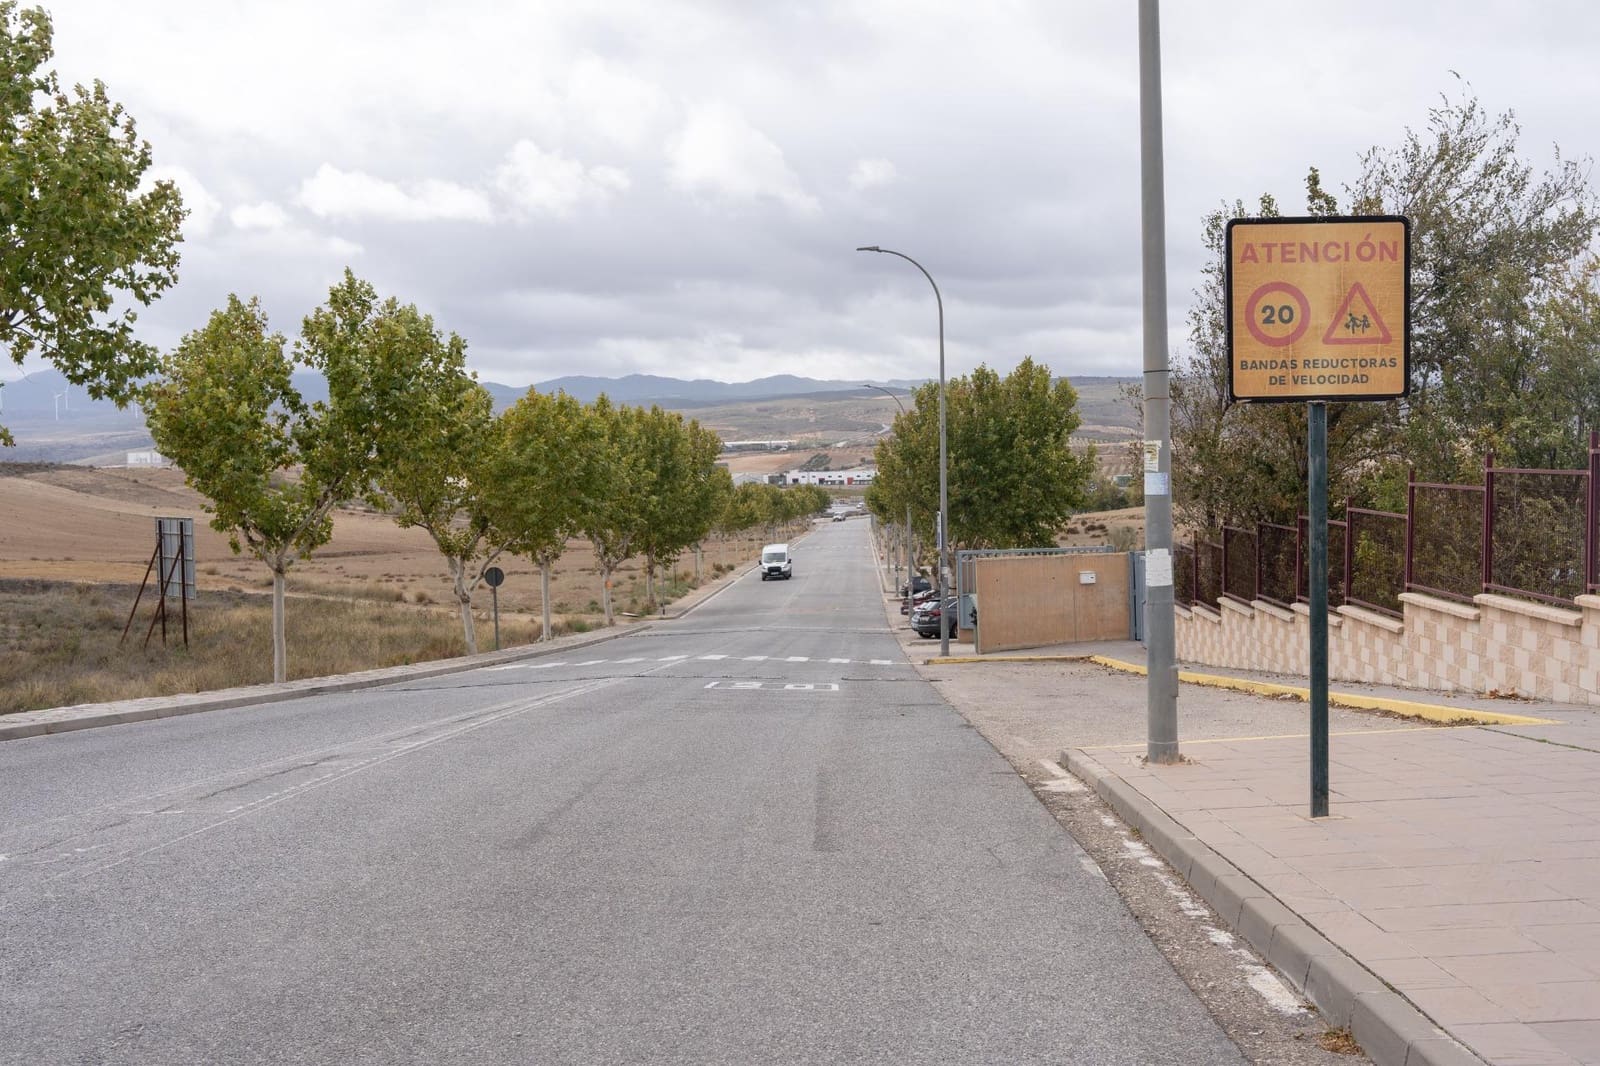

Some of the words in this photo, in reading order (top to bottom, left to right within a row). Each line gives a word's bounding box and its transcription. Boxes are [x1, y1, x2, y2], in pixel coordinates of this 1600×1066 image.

[1240, 233, 1398, 263] ATENCIÓN
[1261, 305, 1294, 324] 20
[1240, 359, 1298, 370] BANDAS
[1303, 357, 1397, 369] REDUCTORAS
[1269, 375, 1286, 385] DE
[1292, 374, 1369, 385] VELOCIDAD
